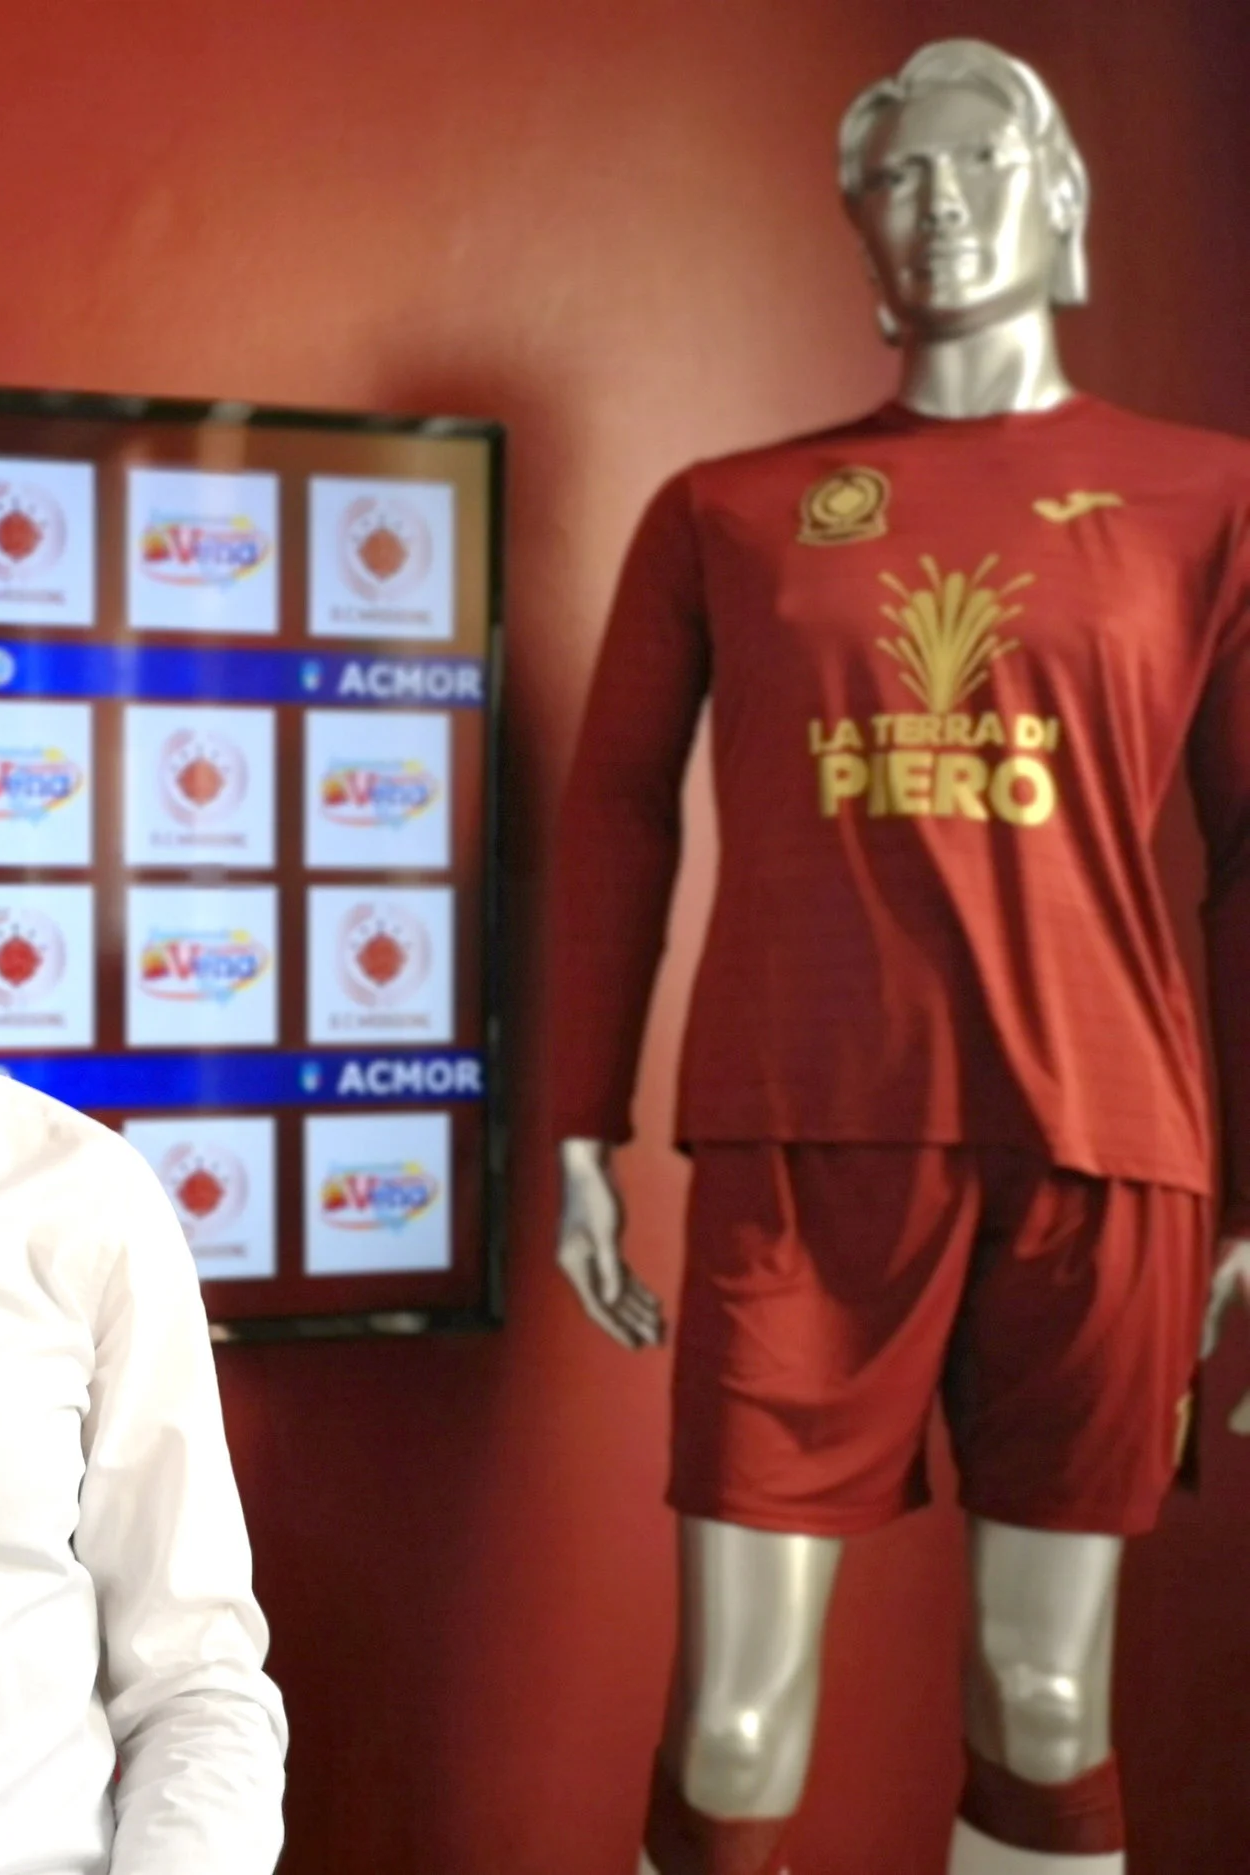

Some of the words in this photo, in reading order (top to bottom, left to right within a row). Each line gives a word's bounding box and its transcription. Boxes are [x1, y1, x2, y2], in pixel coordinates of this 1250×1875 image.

[337, 661, 484, 699] ACMOR
[808, 717, 864, 754] LA
[870, 712, 1005, 748] TERRA
[1014, 713, 1061, 753] DI
[818, 750, 1057, 828] PIERO
[337, 1060, 482, 1096] ACMOR
